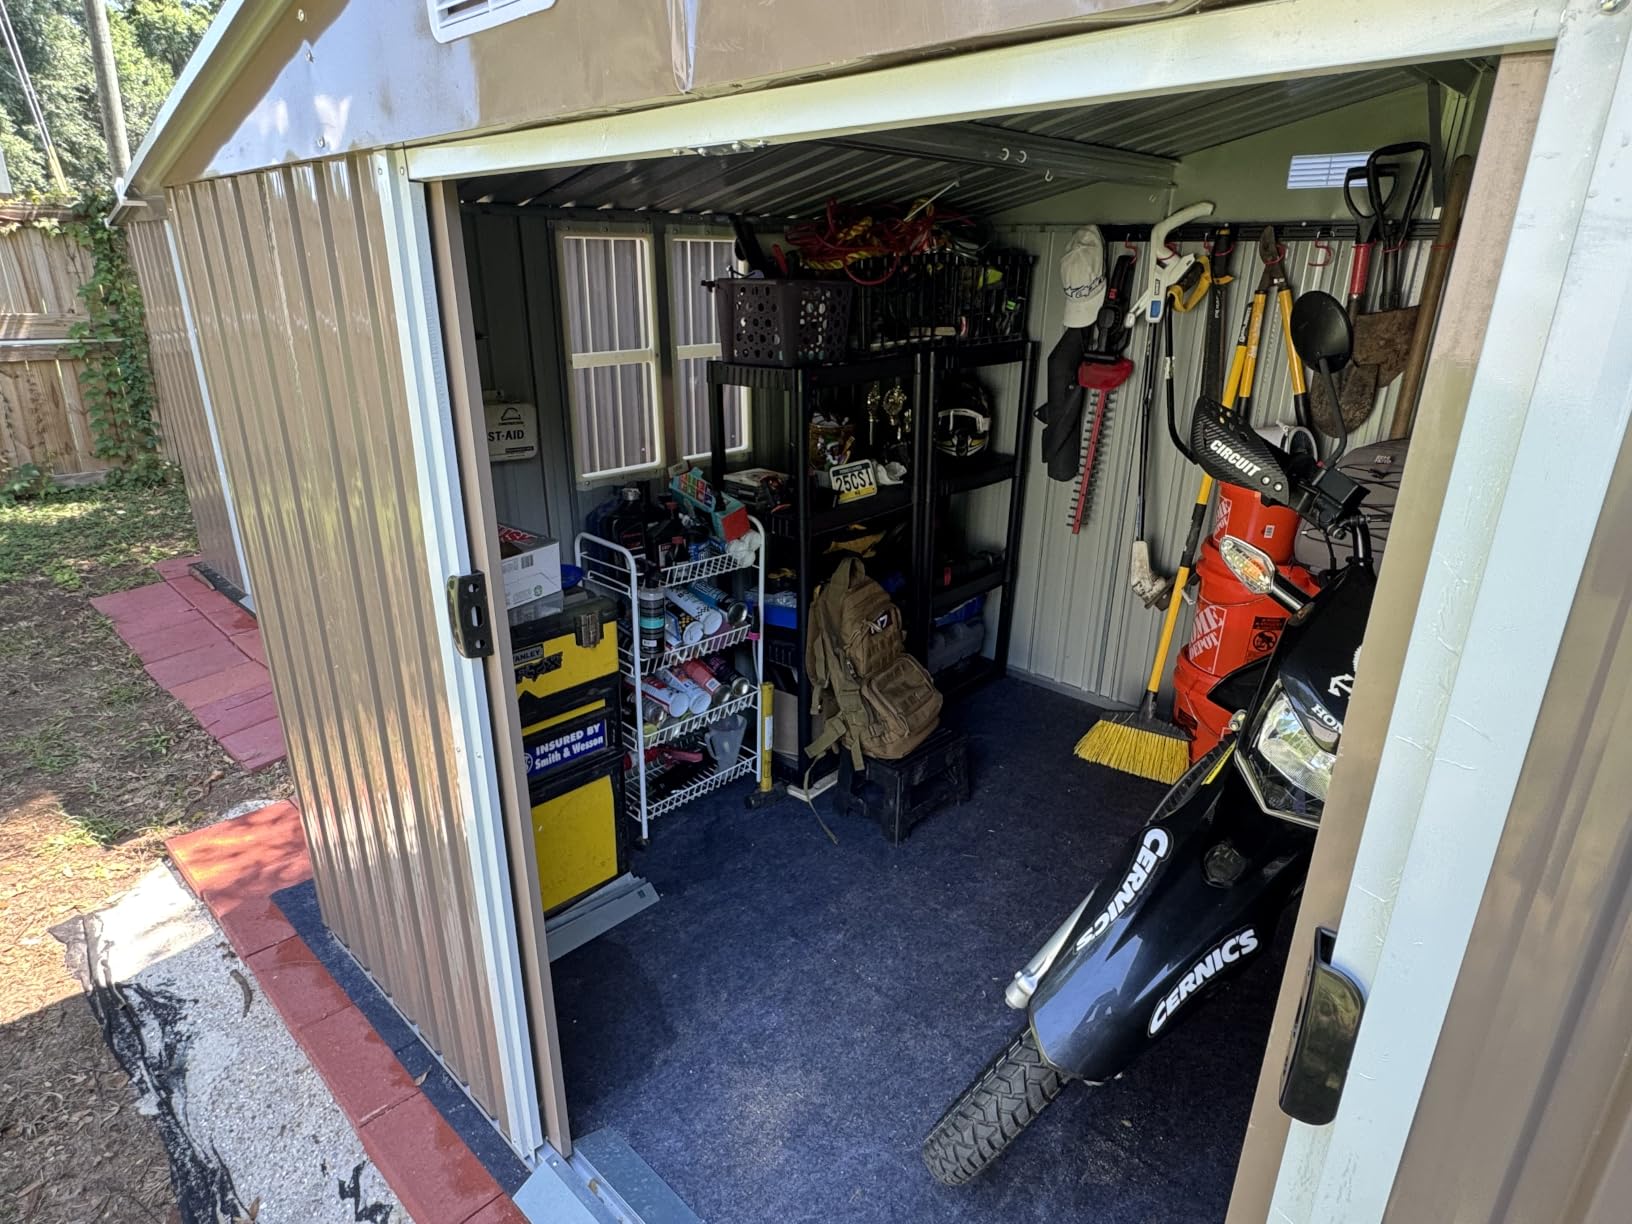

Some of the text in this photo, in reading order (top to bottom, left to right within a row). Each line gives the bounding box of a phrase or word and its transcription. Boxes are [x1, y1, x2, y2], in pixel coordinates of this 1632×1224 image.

[1209, 438, 1262, 477] CIRCUIT
[1191, 605, 1224, 641] OME
[513, 648, 541, 663] ANLEY
[534, 735, 604, 770] Smith & Wesson
[535, 722, 601, 757] INSURED BY
[1149, 928, 1259, 1036] CERNIC'S
